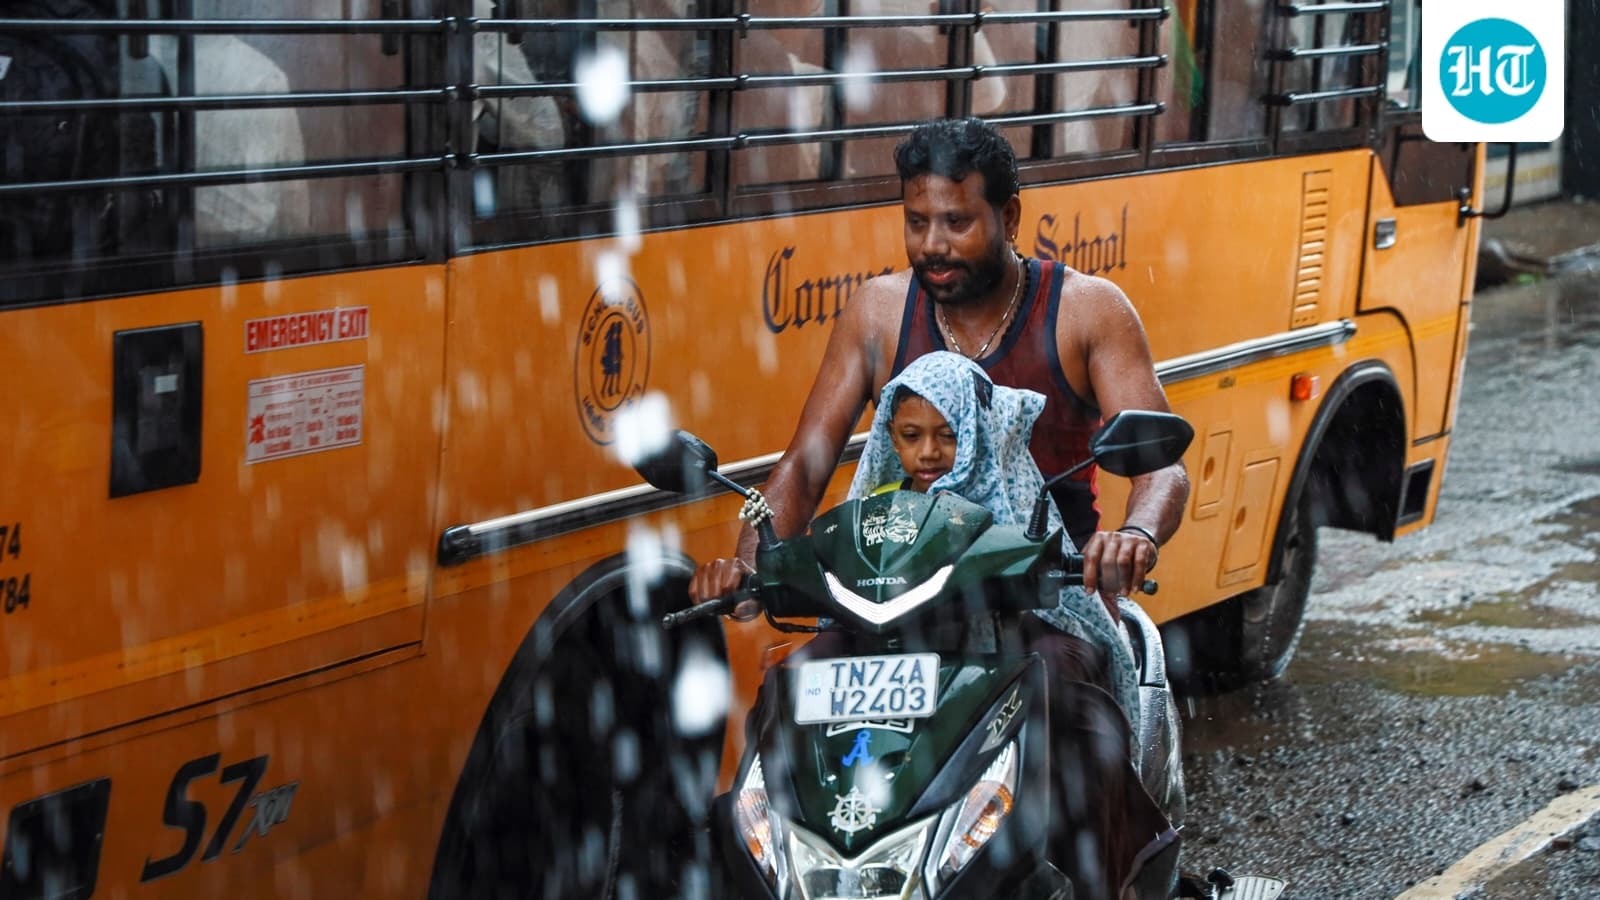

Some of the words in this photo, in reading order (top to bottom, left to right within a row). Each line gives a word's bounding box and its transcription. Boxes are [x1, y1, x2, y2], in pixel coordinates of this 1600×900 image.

[763, 246, 895, 334] Corp
[1034, 201, 1128, 275] School
[246, 311, 336, 352] EMERGENCY
[338, 307, 368, 339] EXIT
[856, 576, 907, 588] HONDA
[831, 658, 924, 688] TN74A
[805, 687, 821, 697] IND
[831, 686, 927, 716] W2403
[139, 752, 269, 884] S7
